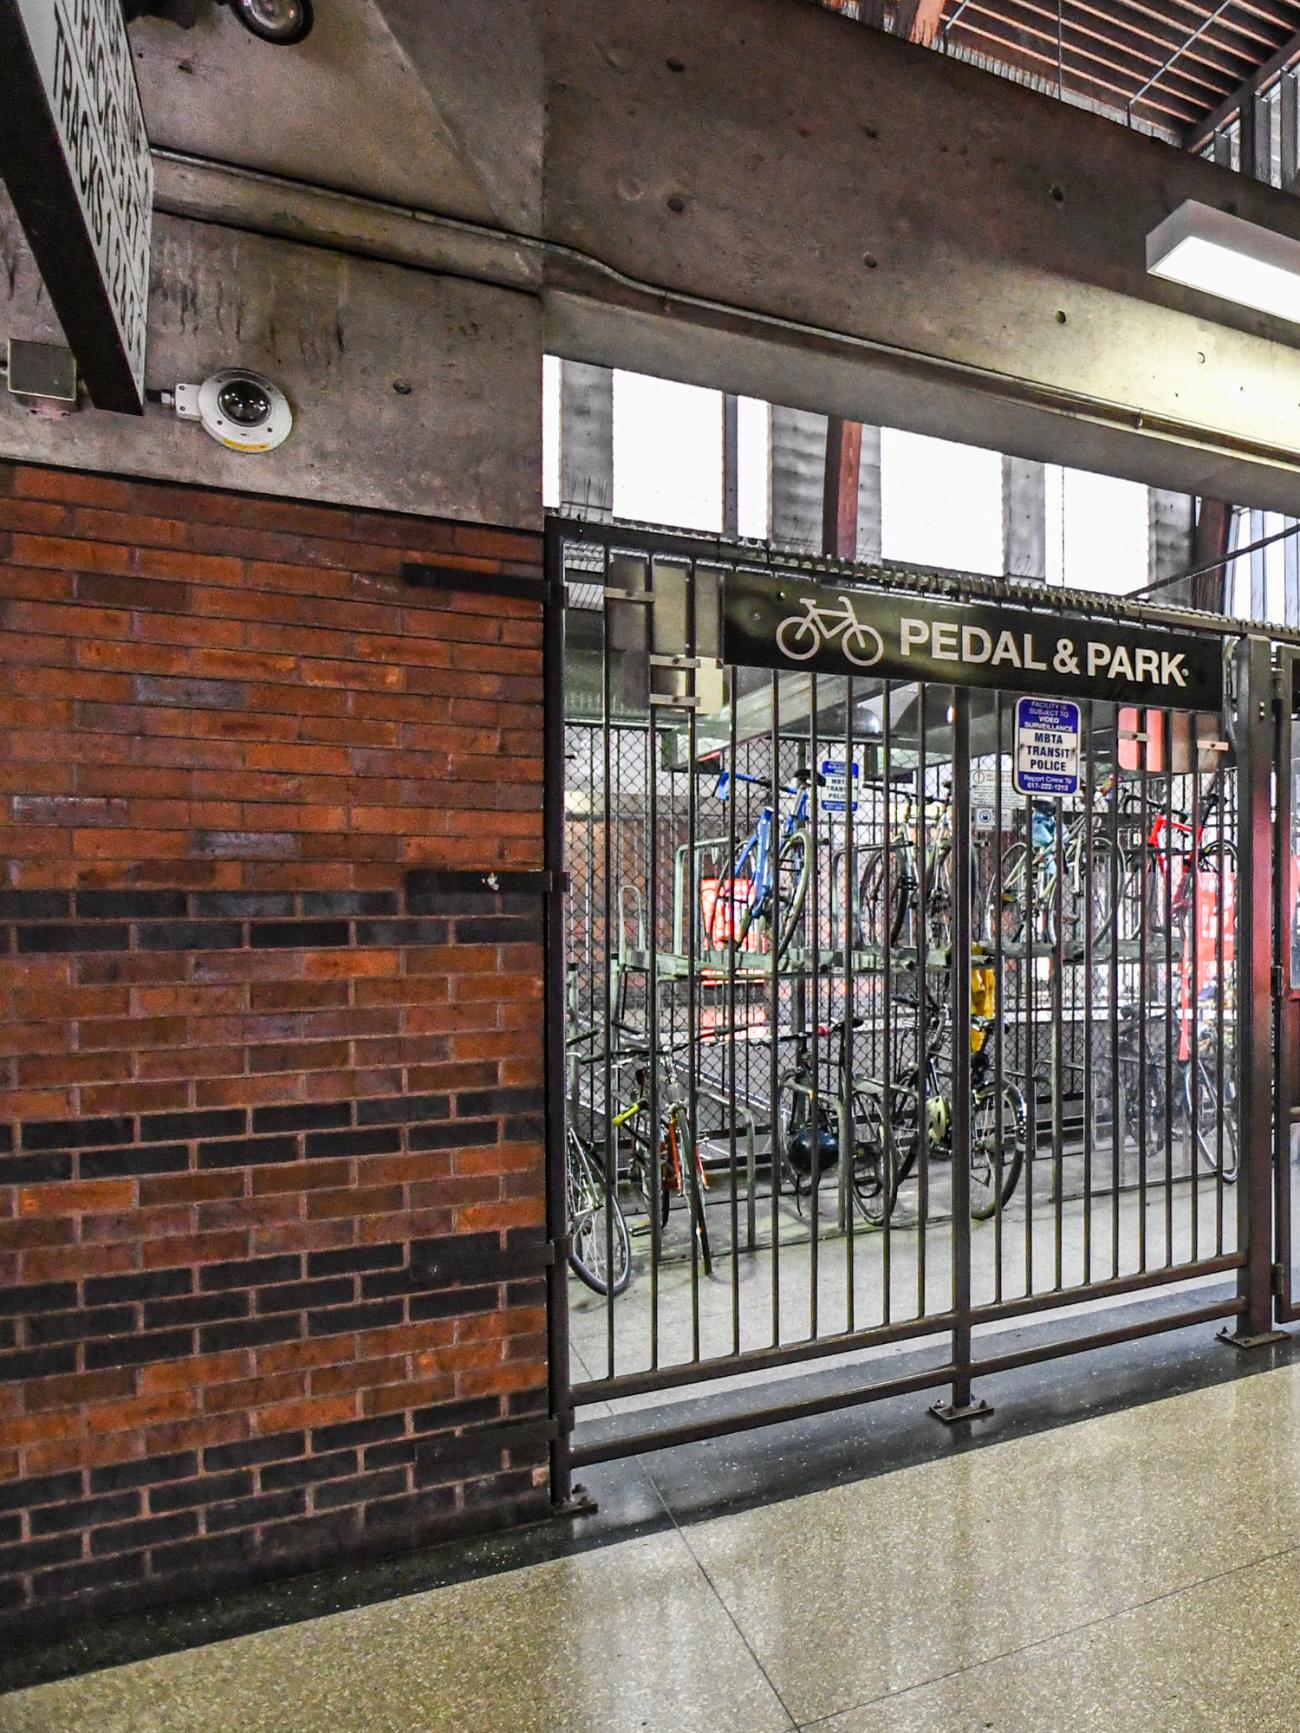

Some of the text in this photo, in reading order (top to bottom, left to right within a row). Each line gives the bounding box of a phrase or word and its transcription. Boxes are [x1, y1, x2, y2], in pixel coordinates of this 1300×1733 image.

[53, 1, 105, 246] TRACKS
[899, 617, 1189, 688] PEDAL & PARK
[1031, 700, 1059, 710] FACILITY
[1028, 708, 1070, 719] SUBJECT TO
[1038, 716, 1060, 724] VIDEO
[1023, 721, 1073, 733] SURVEILLANCE
[1034, 732, 1063, 745] MBTA
[1026, 745, 1069, 759] TRANSIT
[1029, 759, 1066, 772] POLICE
[1023, 774, 1073, 785] Report Crime To
